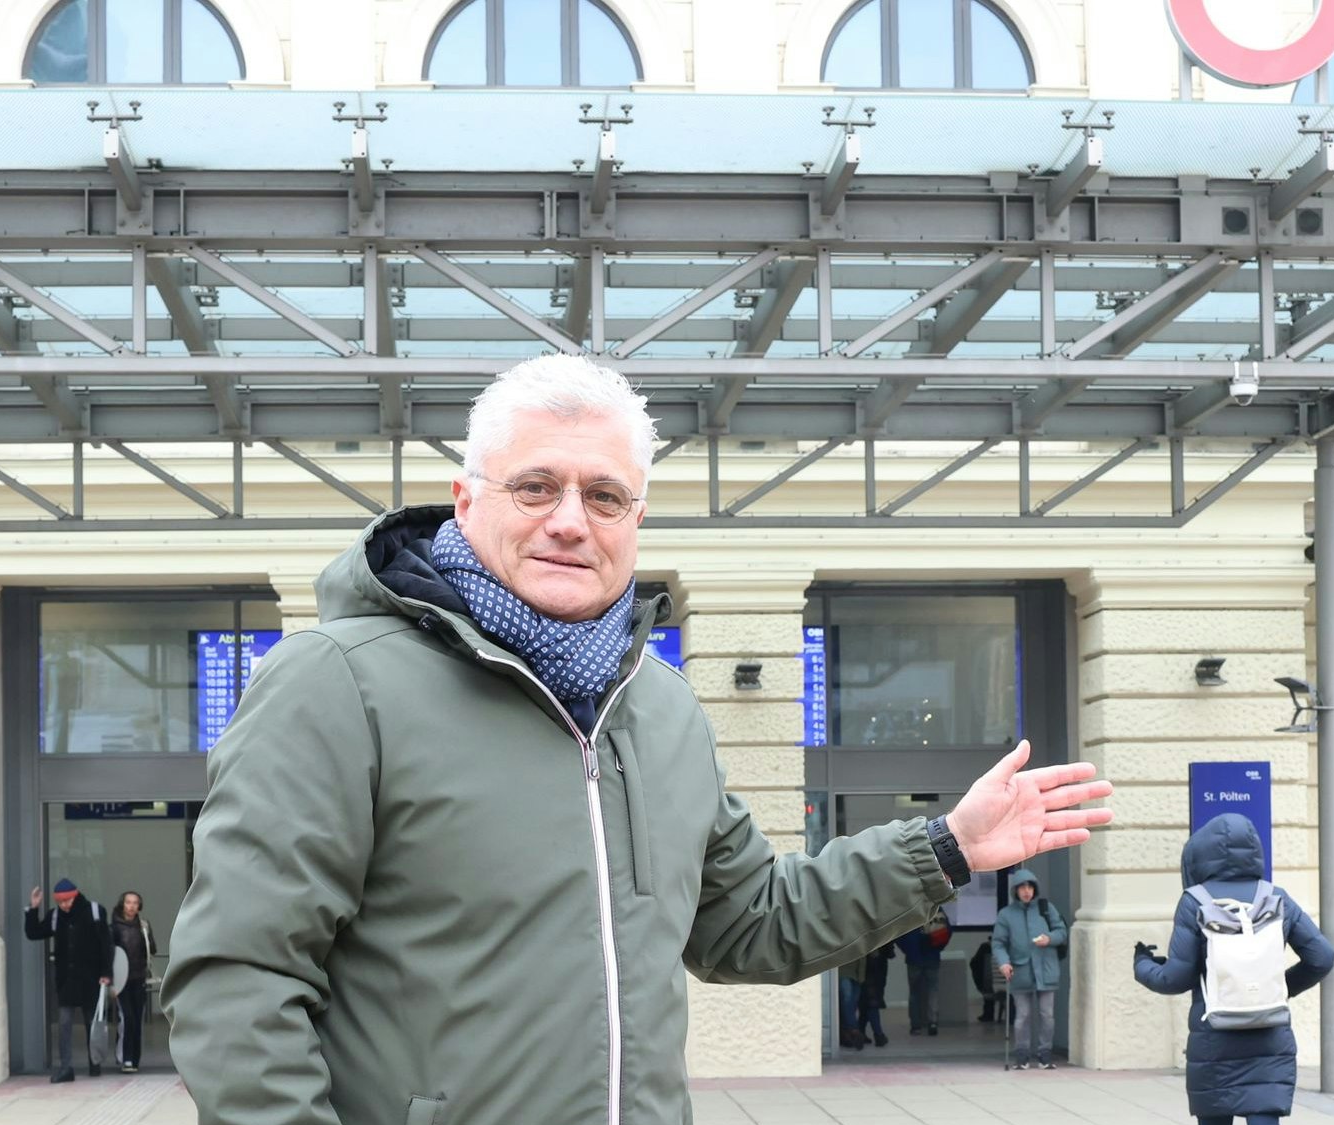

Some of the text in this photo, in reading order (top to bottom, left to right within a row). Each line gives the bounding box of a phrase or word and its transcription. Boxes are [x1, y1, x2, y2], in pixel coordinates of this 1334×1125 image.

[218, 634, 255, 644] Abfhrt
[1204, 791, 1251, 802] St. Pölten
